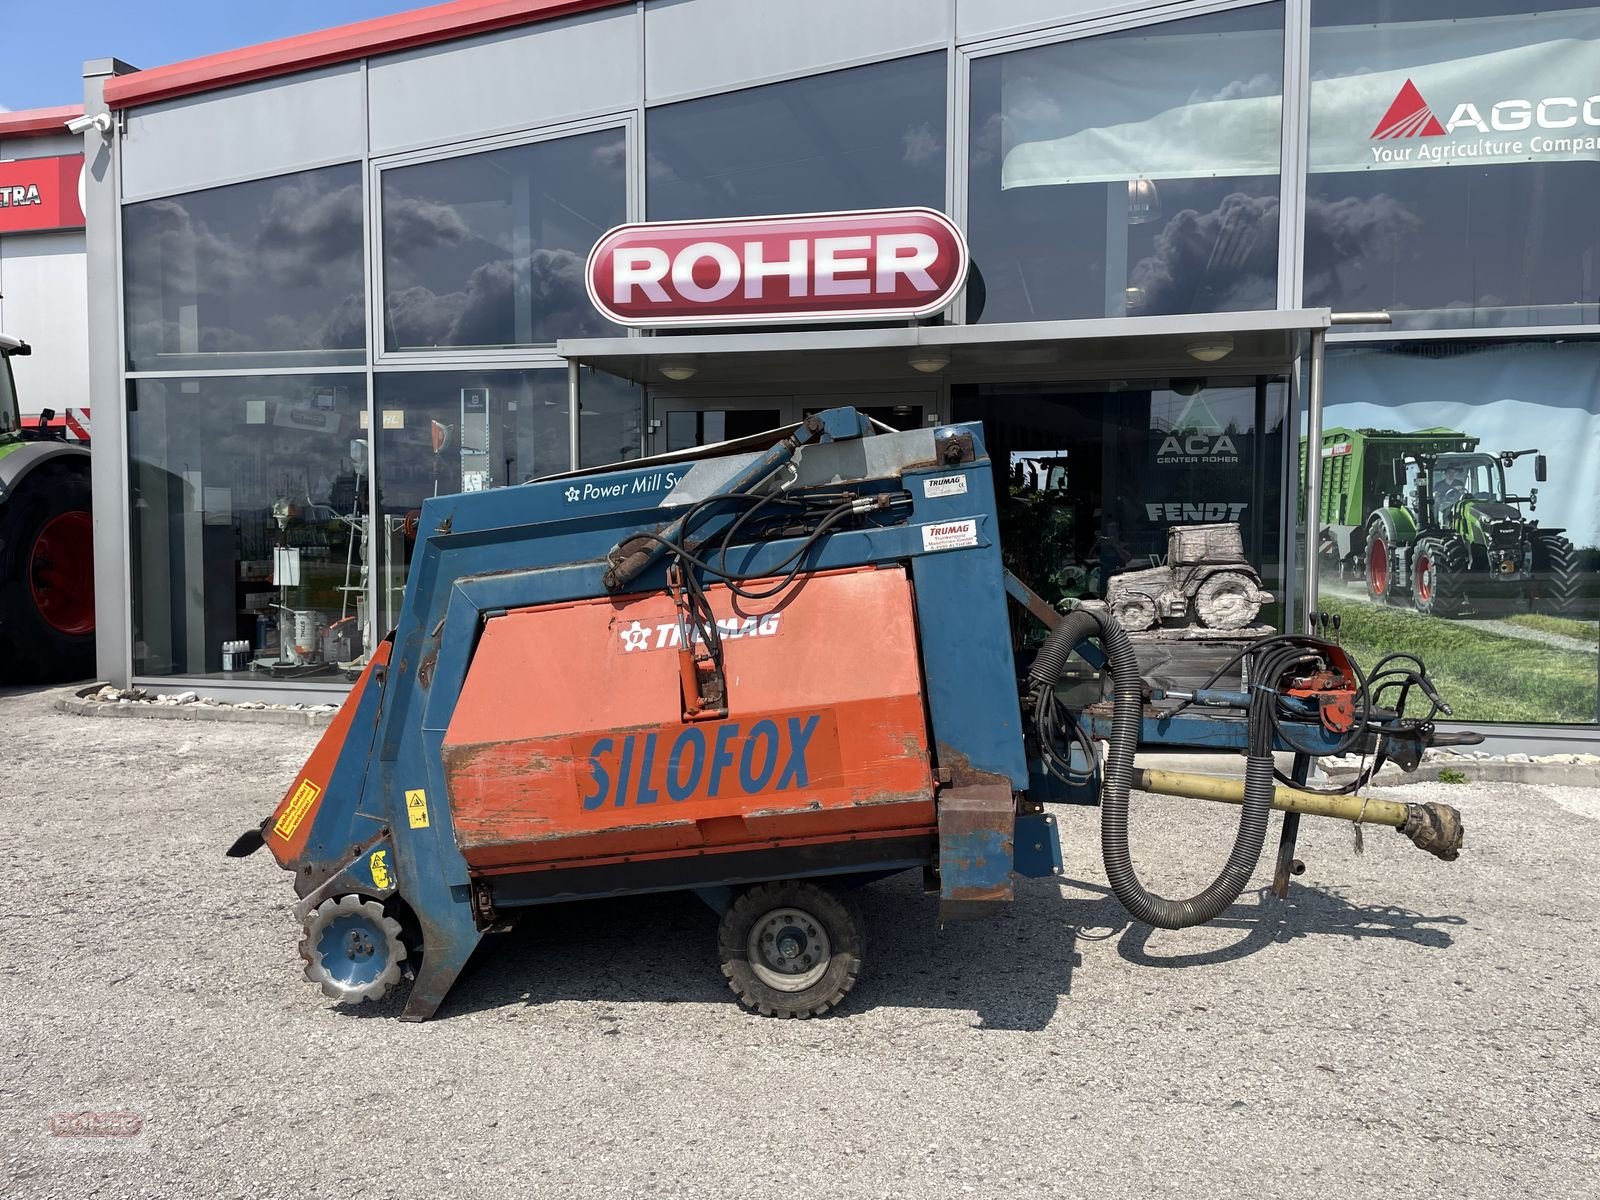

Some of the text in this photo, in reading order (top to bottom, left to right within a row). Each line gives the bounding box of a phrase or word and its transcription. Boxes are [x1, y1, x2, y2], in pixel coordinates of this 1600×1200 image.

[1371, 136, 1600, 163] Your Agriculture Compa
[0, 184, 41, 207] TRA
[613, 233, 941, 304] ROHER
[1156, 434, 1238, 456] ACA
[583, 483, 629, 500] Power
[632, 474, 662, 494] Mill
[929, 476, 960, 487] TRUMAG
[1145, 503, 1249, 521] FENDT
[930, 524, 969, 536] TRUMAG
[583, 714, 820, 810] SILOFOX
